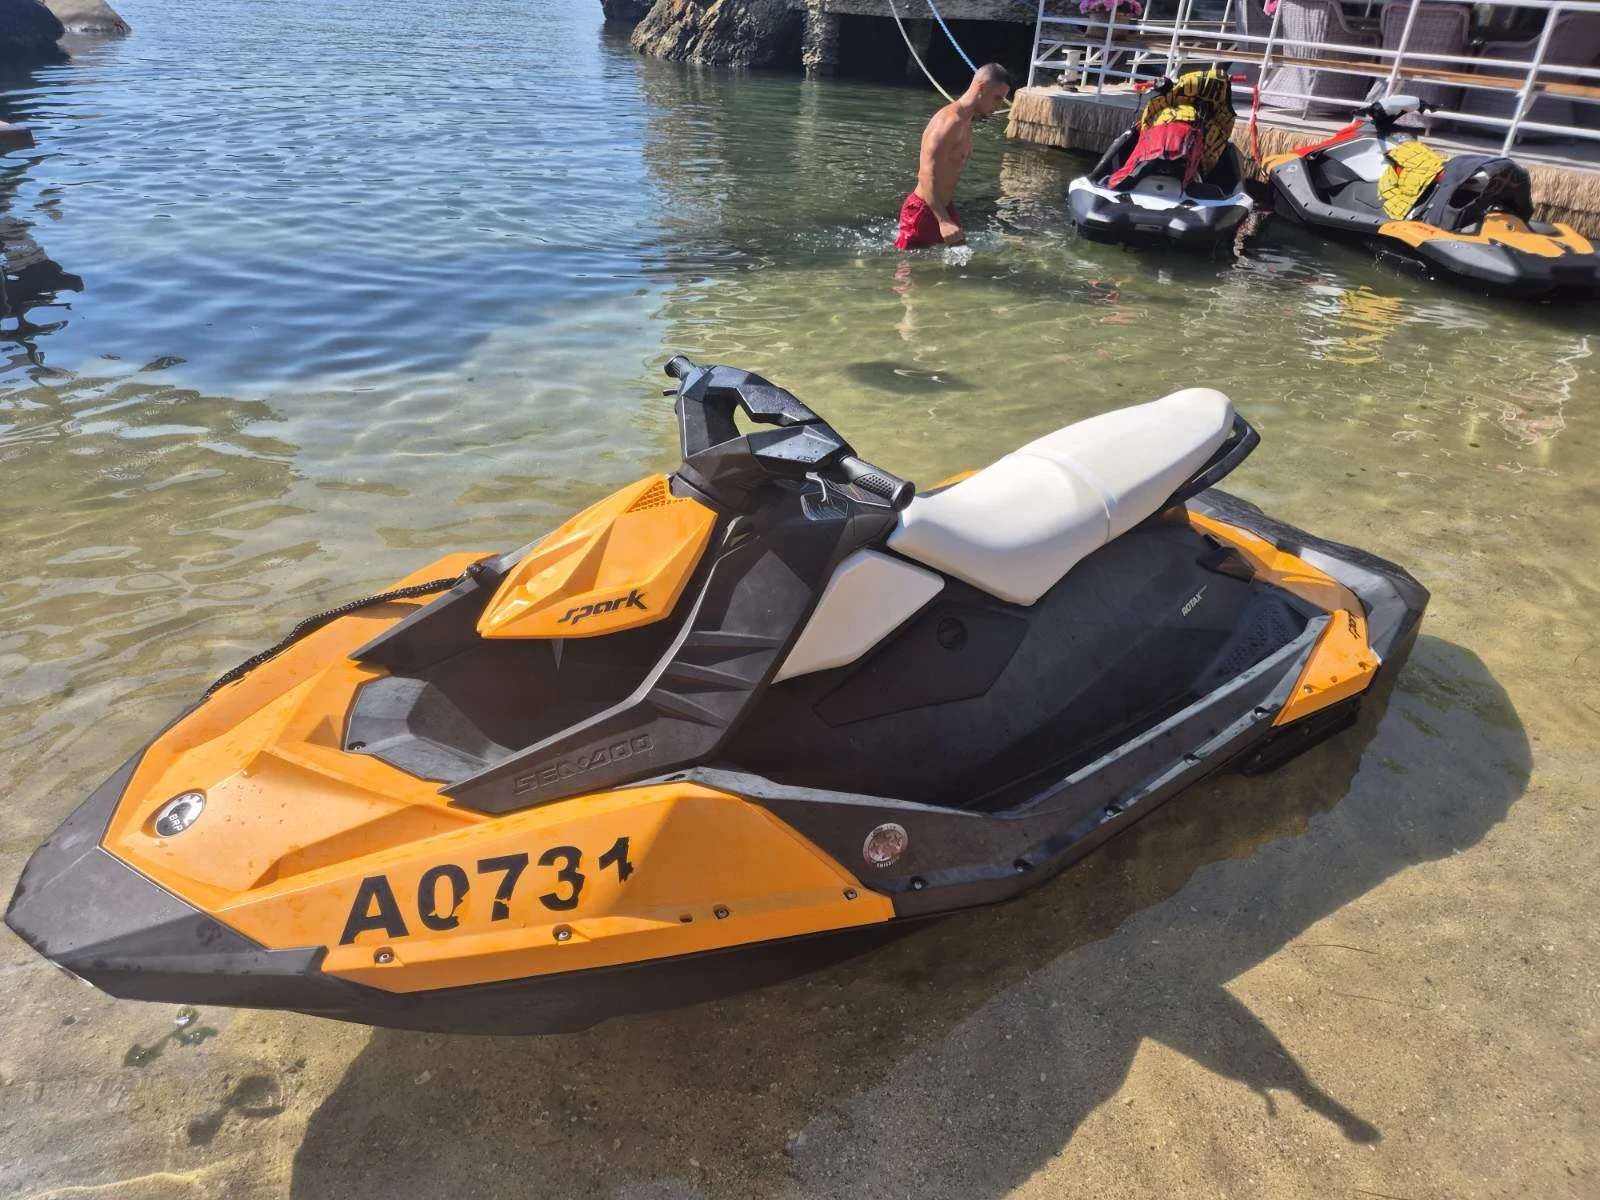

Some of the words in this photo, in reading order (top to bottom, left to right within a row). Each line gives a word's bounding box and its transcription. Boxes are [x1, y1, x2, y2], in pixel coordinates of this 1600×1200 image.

[557, 588, 649, 626] spark
[1181, 592, 1203, 616] ROTAX
[169, 814, 183, 831] BRP
